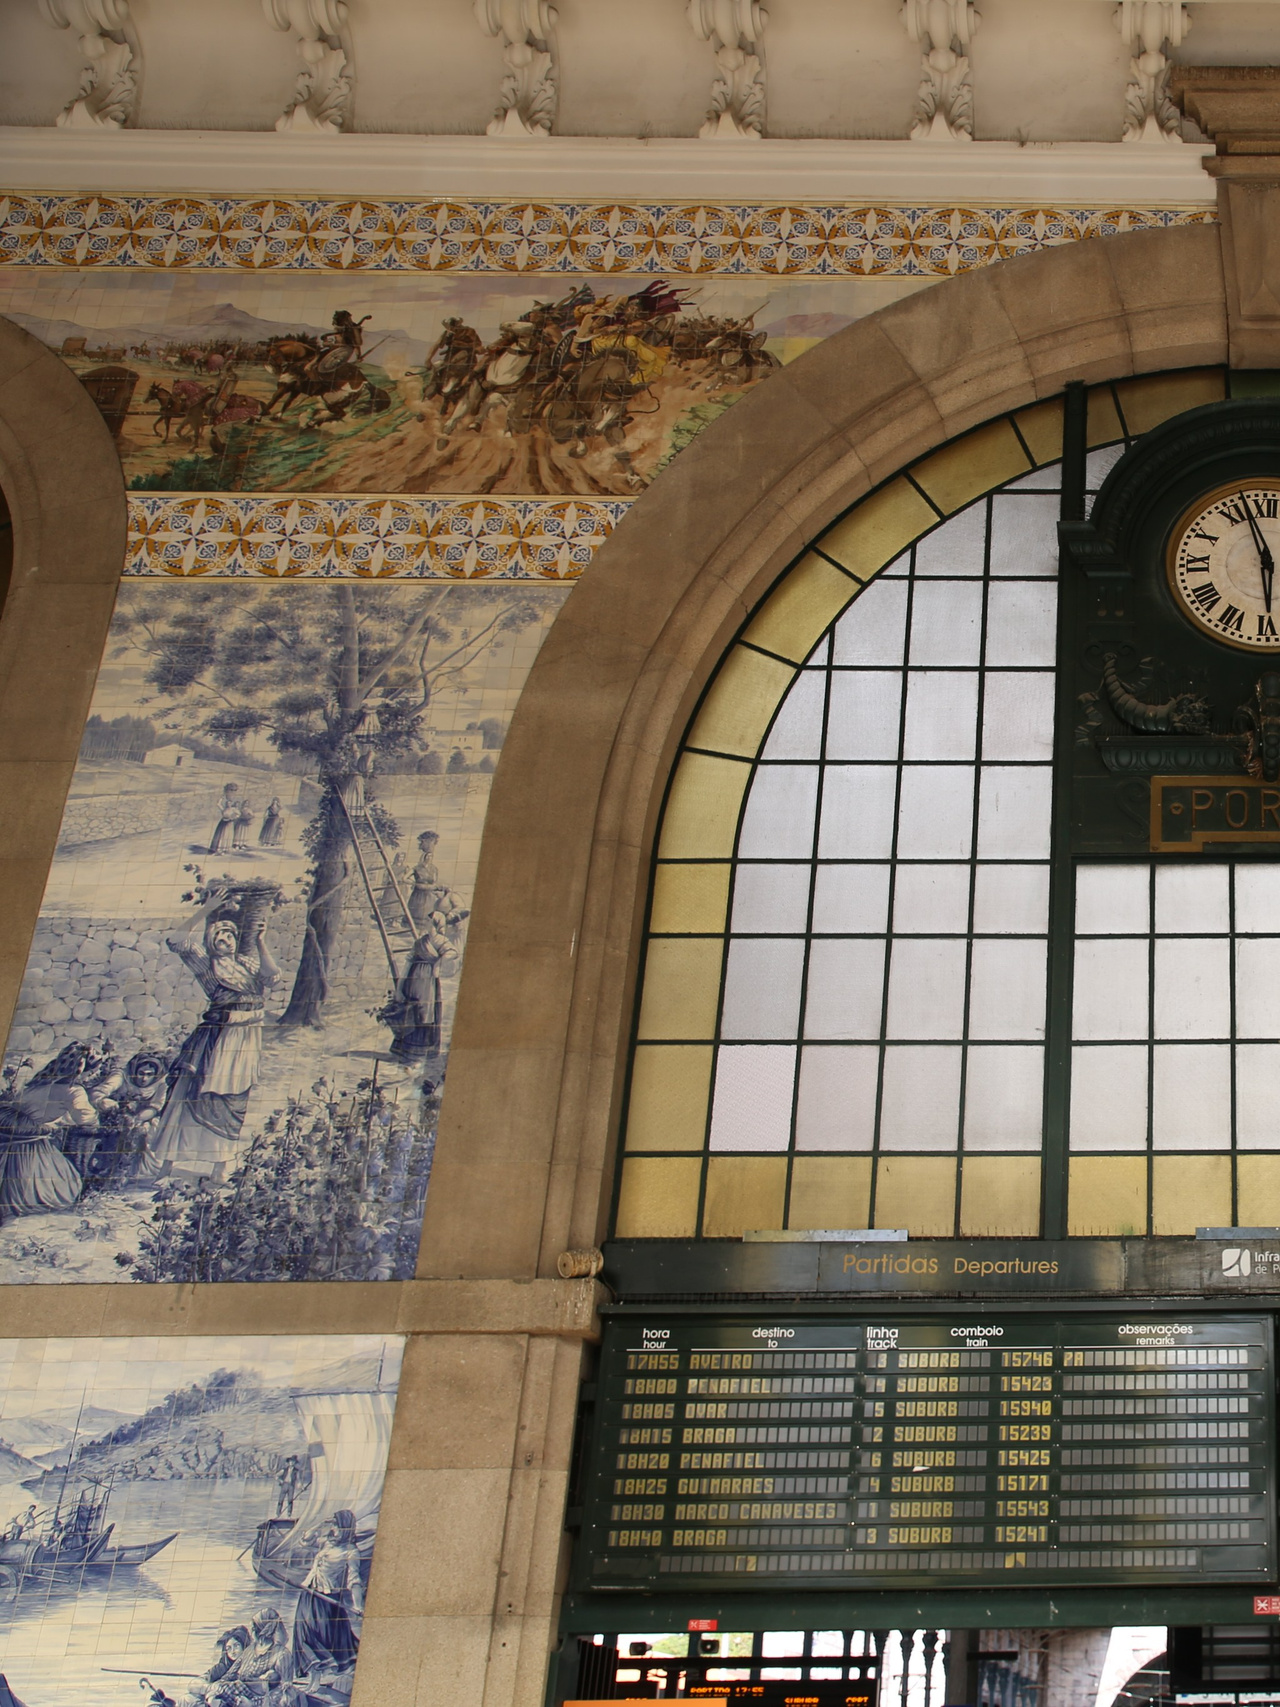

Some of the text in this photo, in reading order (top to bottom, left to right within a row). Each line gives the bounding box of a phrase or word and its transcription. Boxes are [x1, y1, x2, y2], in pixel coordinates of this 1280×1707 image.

[1217, 503, 1248, 527] XI
[1251, 498, 1280, 519] XII
[1194, 527, 1220, 547] X
[1186, 553, 1211, 574] IX
[1191, 581, 1222, 614] VIII
[1217, 603, 1246, 632] VII
[1256, 614, 1278, 636] VI
[843, 1252, 1059, 1277] Partidas Departures
[1255, 1263, 1268, 1274] de
[642, 1328, 670, 1338] hora
[752, 1328, 794, 1338] destino
[866, 1326, 898, 1338] linha
[950, 1326, 1004, 1336] comboio
[1118, 1324, 1193, 1336] observações
[643, 1340, 666, 1348] hour
[768, 1340, 778, 1348] to
[867, 1338, 897, 1348] track
[966, 1338, 988, 1346] train
[1136, 1336, 1175, 1346] remarks
[627, 1352, 1084, 1370] 17H55 AVEIRO 3 SUBURB 15746 PA
[624, 1376, 1052, 1394] 18H00 PENAFIEL 4 SUBURB 15423
[622, 1400, 1052, 1419] 18H05 OVAR 5 SUBURB 15940
[619, 1425, 1051, 1444] 18H15 BRAGA 2 SUBURB 15239
[616, 1450, 1050, 1470] 18H20 PENAFIEL 6 SUBURB 15425
[614, 1474, 1049, 1495] 18H25 GUIMARAES 4 SUBURB 15171
[611, 1504, 664, 1520] 18H30
[675, 1504, 730, 1520] MARCO
[890, 1501, 953, 1518] SUBURB
[996, 1500, 1048, 1516] 15543
[608, 1526, 1048, 1546] 18H40 BRAGA 3 SUBURB 15241
